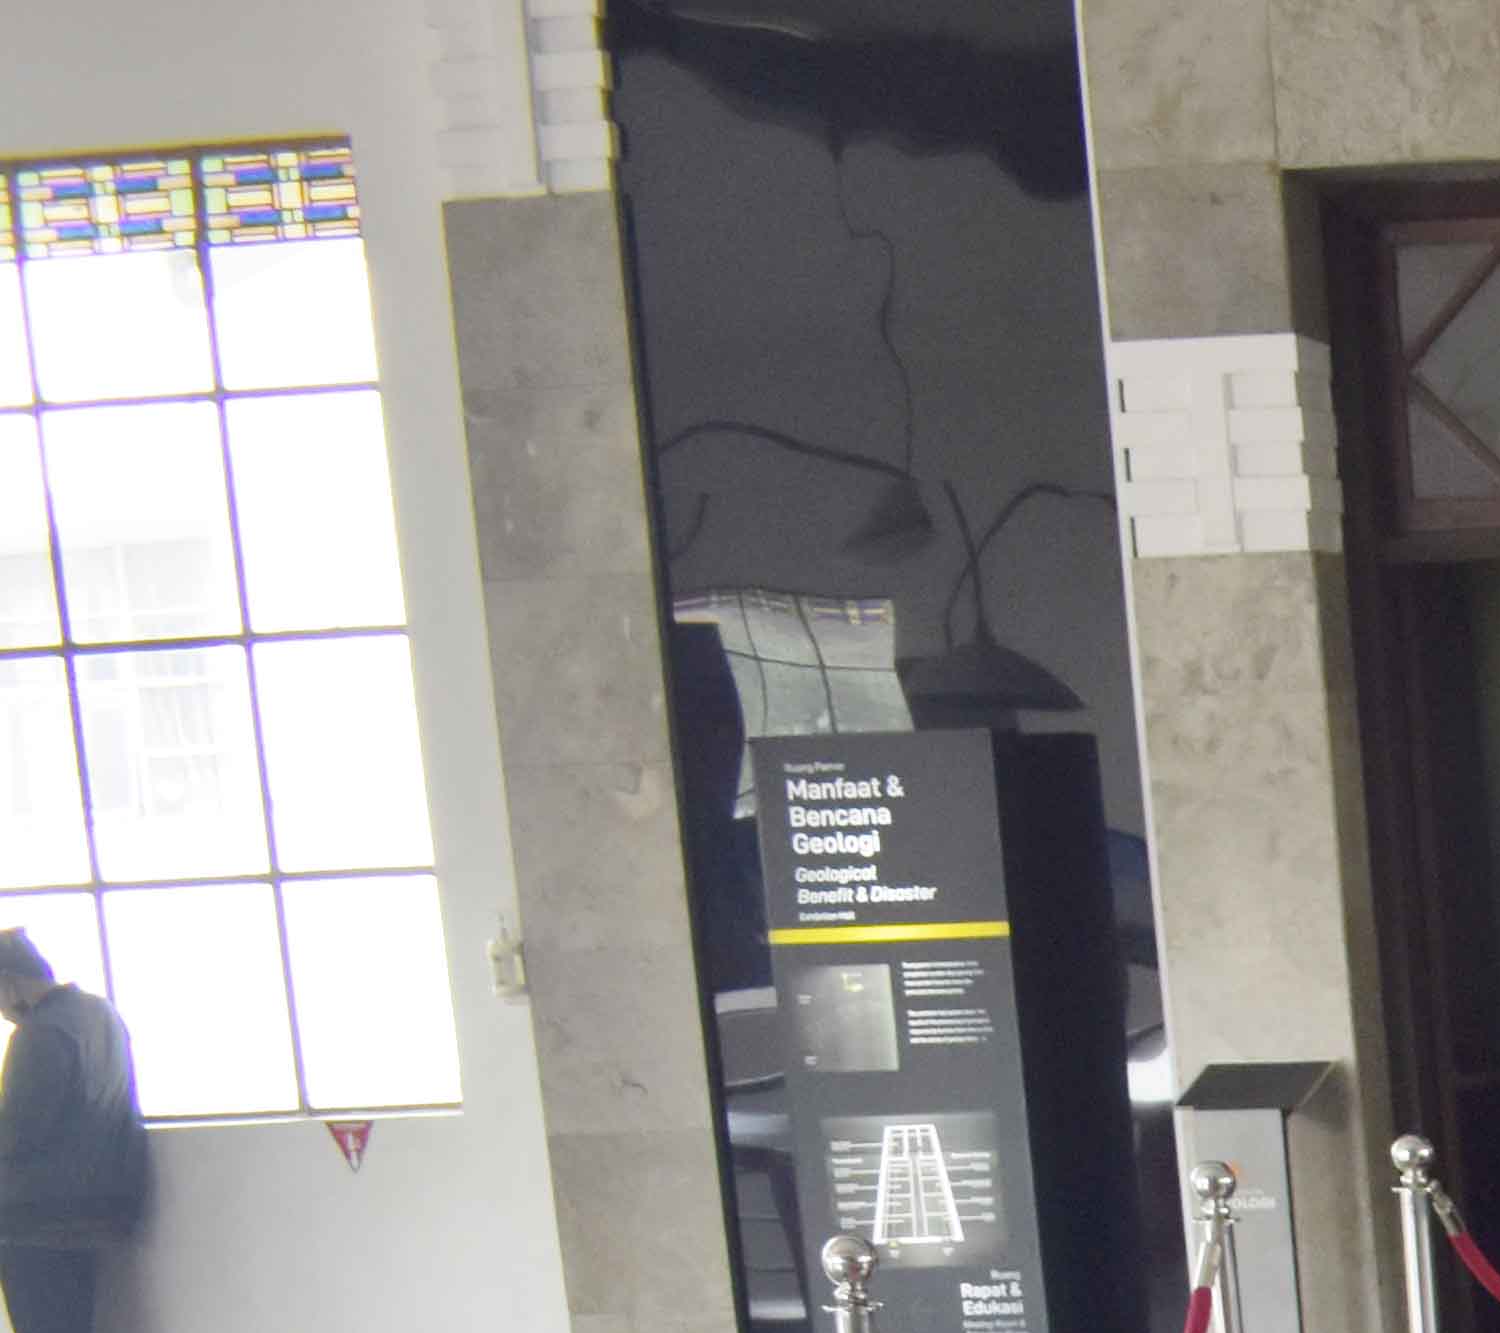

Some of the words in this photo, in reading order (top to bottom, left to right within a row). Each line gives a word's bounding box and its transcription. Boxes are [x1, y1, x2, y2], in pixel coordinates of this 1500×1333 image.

[787, 777, 883, 801] Manfaat
[886, 774, 904, 797] &
[789, 806, 892, 828] Bencana
[792, 830, 881, 857] Geologi
[795, 864, 878, 883] Geological
[797, 887, 854, 904] Benefit
[855, 886, 868, 903] &
[870, 884, 938, 903] Disaster
[960, 1282, 1007, 1300] Rapat
[1009, 1281, 1023, 1297] &
[962, 1299, 1024, 1316] Edukasi
